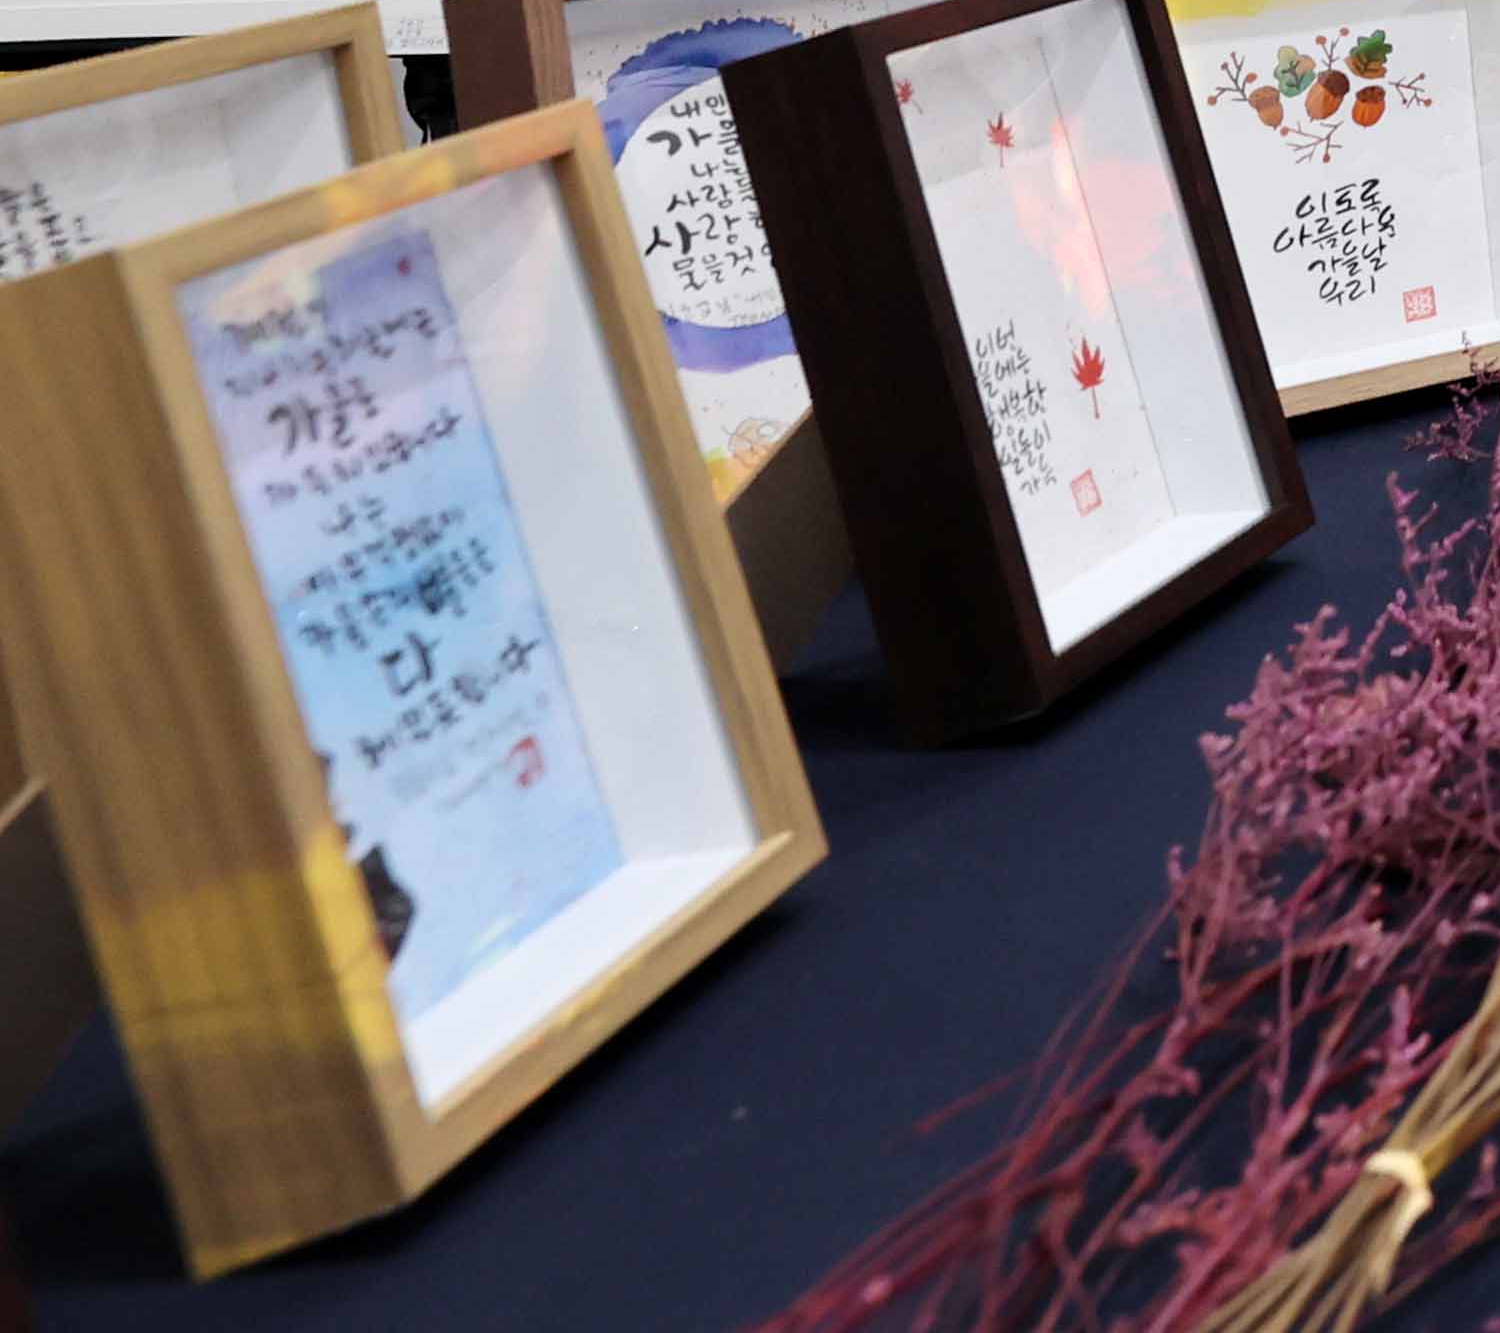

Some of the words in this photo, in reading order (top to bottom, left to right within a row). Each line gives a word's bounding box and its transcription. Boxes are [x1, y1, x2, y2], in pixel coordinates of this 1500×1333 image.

[1295, 178, 1382, 219] 이토록
[1273, 205, 1396, 253] 아름다운
[1308, 237, 1388, 277] 가을날
[1319, 276, 1376, 306] 우리
